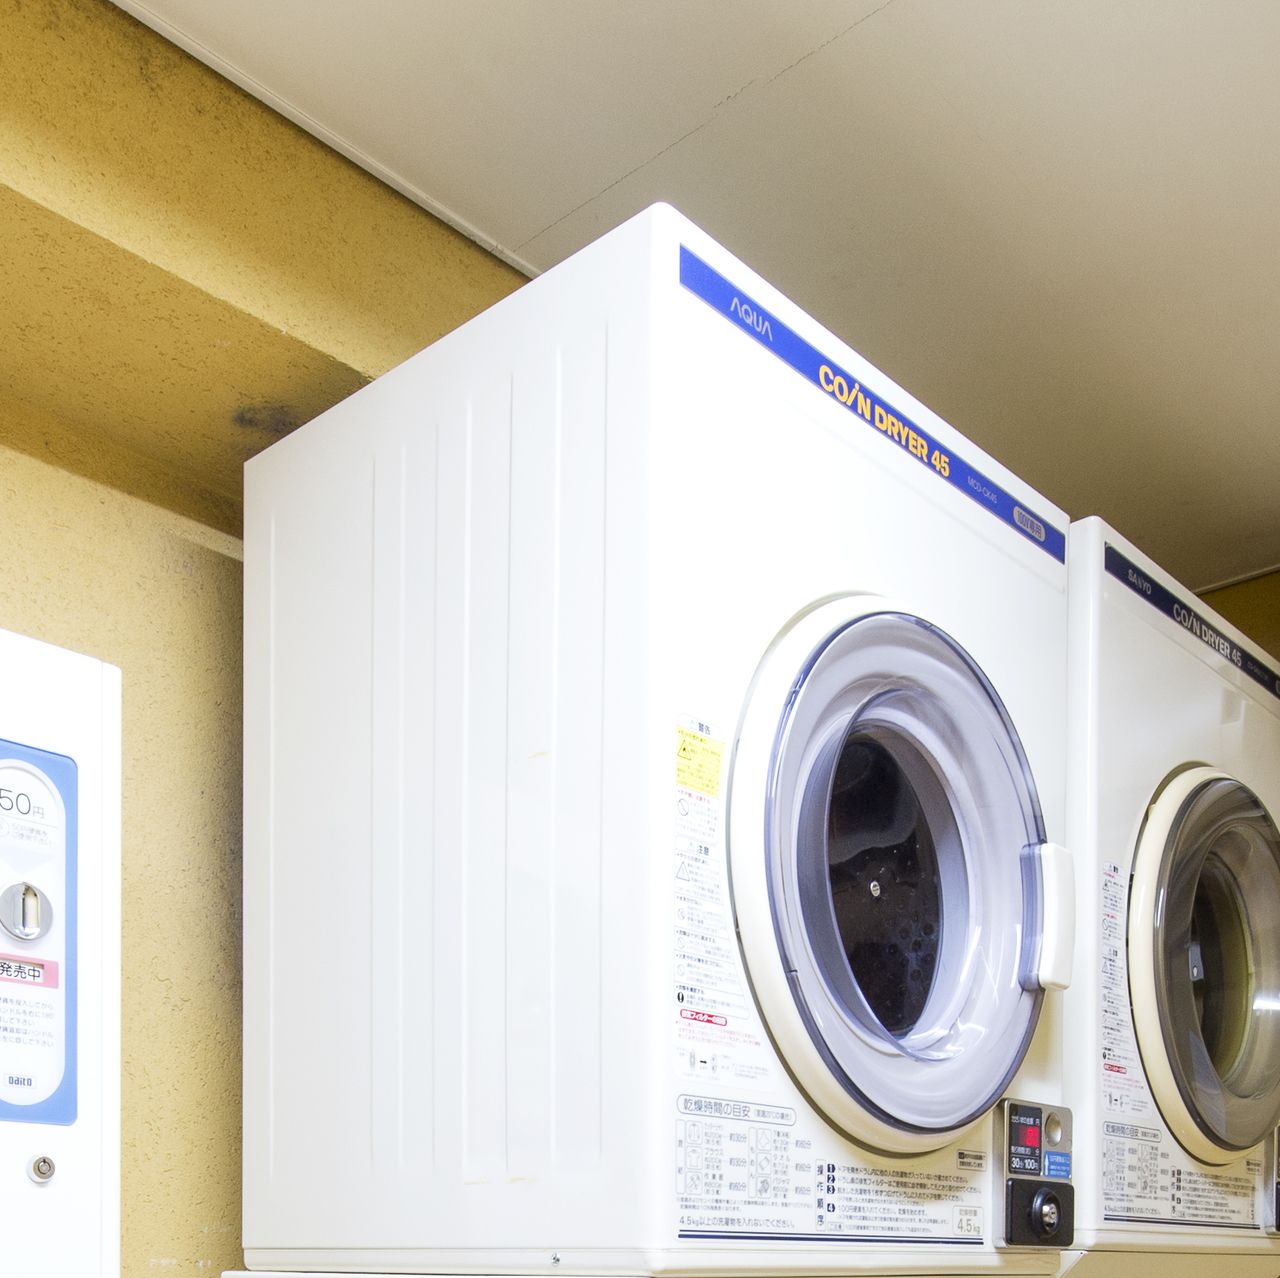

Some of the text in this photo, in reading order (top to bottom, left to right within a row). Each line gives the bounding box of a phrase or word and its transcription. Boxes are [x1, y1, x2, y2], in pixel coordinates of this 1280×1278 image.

[730, 296, 773, 342] AQUA
[875, 405, 928, 463] DRYER
[931, 449, 950, 478] 45
[1127, 569, 1152, 596] SANYO
[1202, 626, 1230, 659] DRYER
[1231, 648, 1242, 668] 45
[0, 961, 41, 981] 発売中
